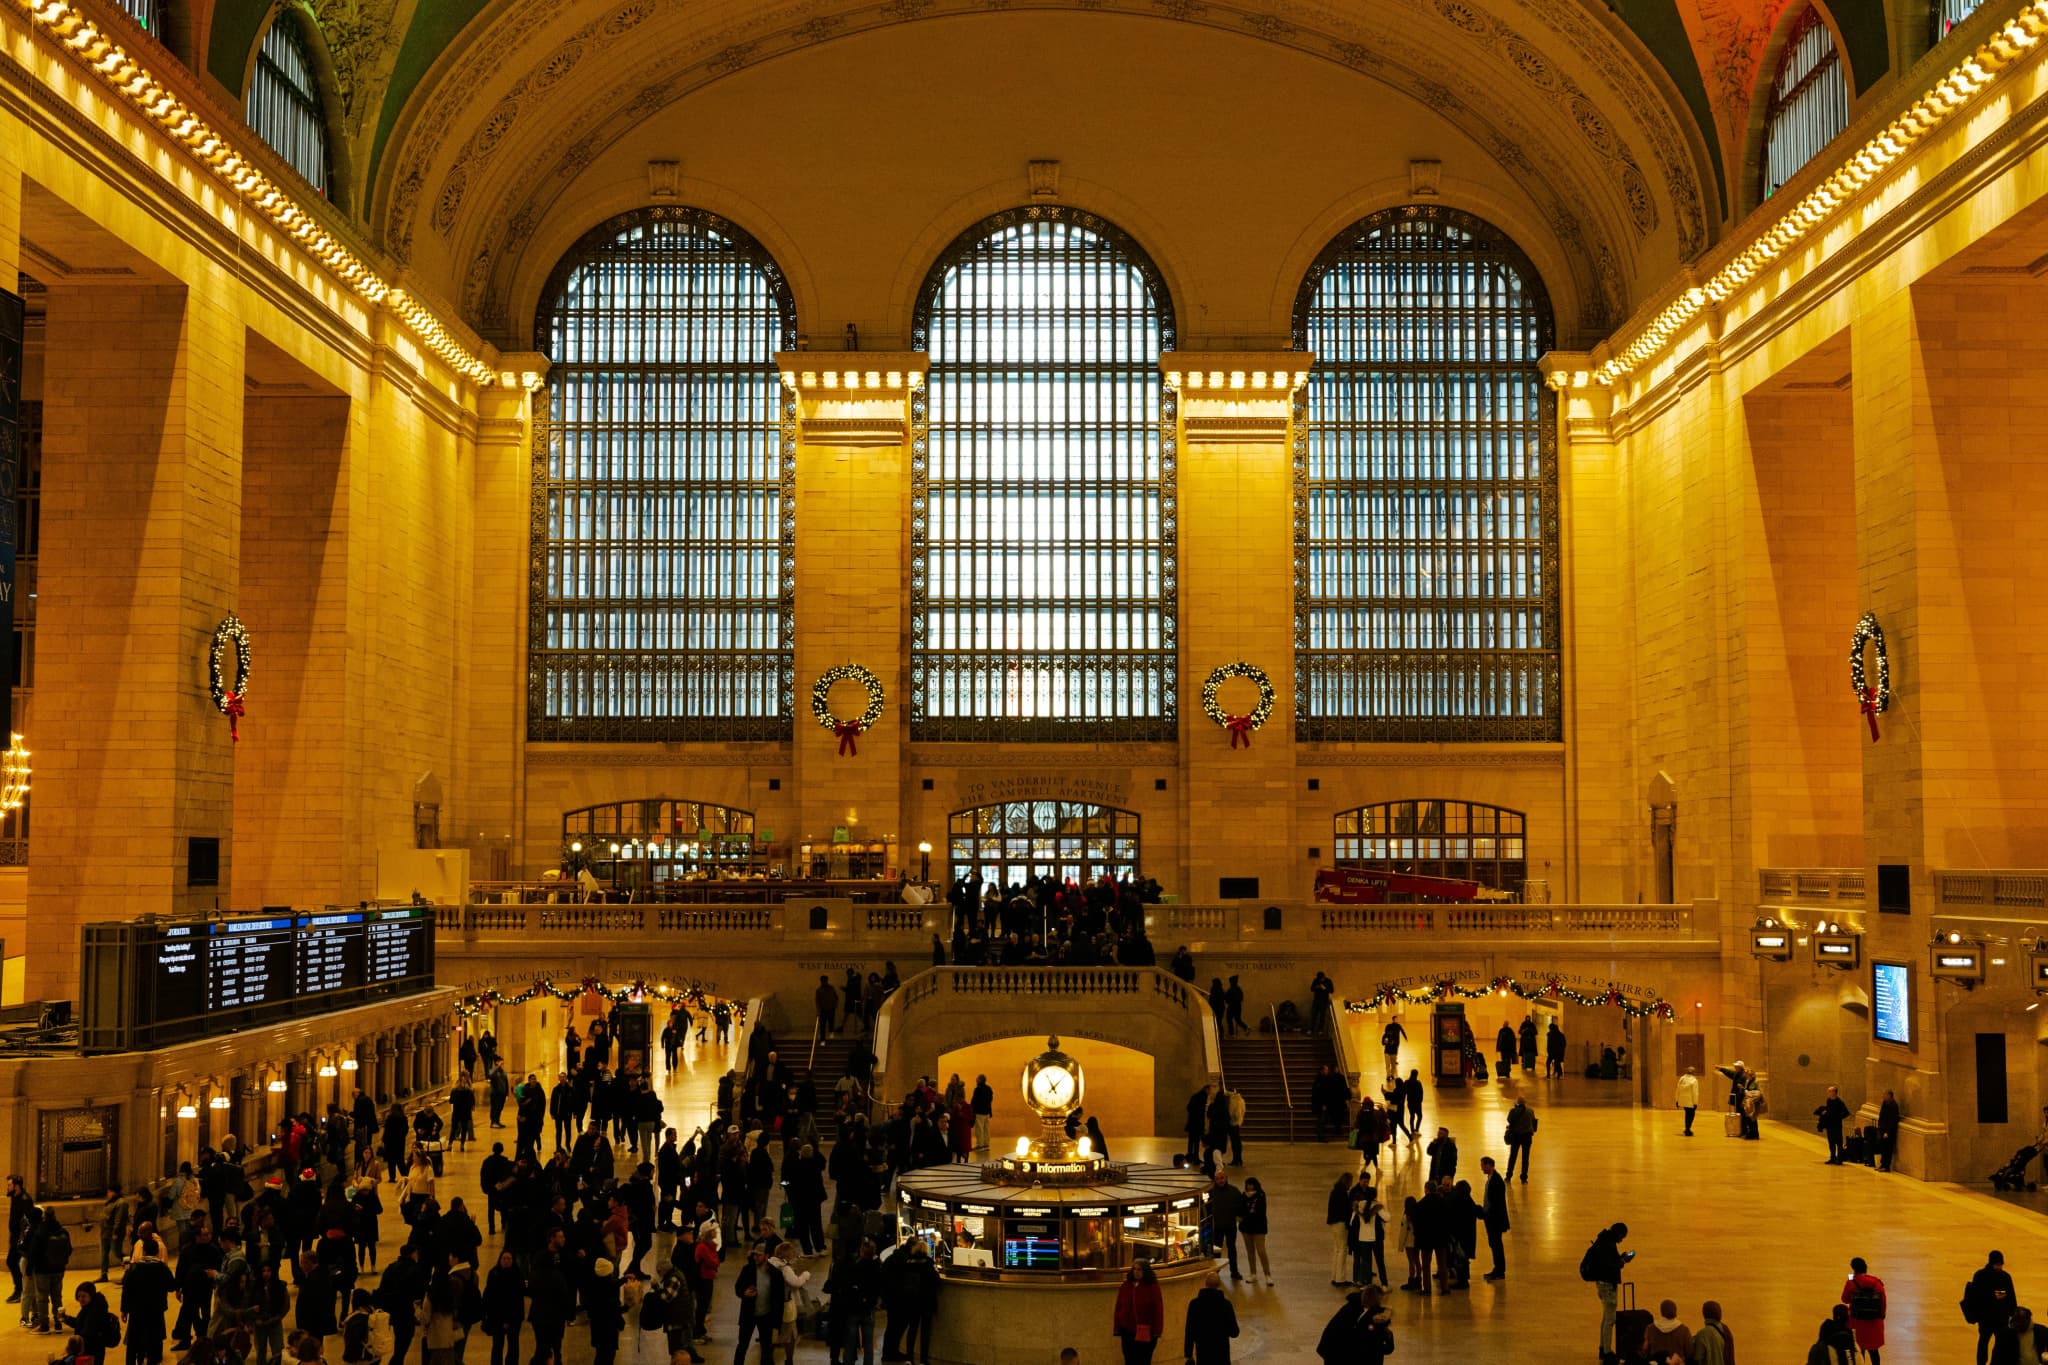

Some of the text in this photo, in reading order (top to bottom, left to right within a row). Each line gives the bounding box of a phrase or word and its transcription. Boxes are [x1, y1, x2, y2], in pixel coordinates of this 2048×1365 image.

[968, 783, 985, 793] TO
[612, 969, 658, 981] SUBWAY
[1419, 969, 1481, 983] MACHINES
[1521, 970, 1569, 982] TRACKS
[1571, 976, 1582, 985] 31
[1591, 977, 1606, 988] 42
[1616, 982, 1643, 996] LIRR
[1036, 1162, 1086, 1174] Information
